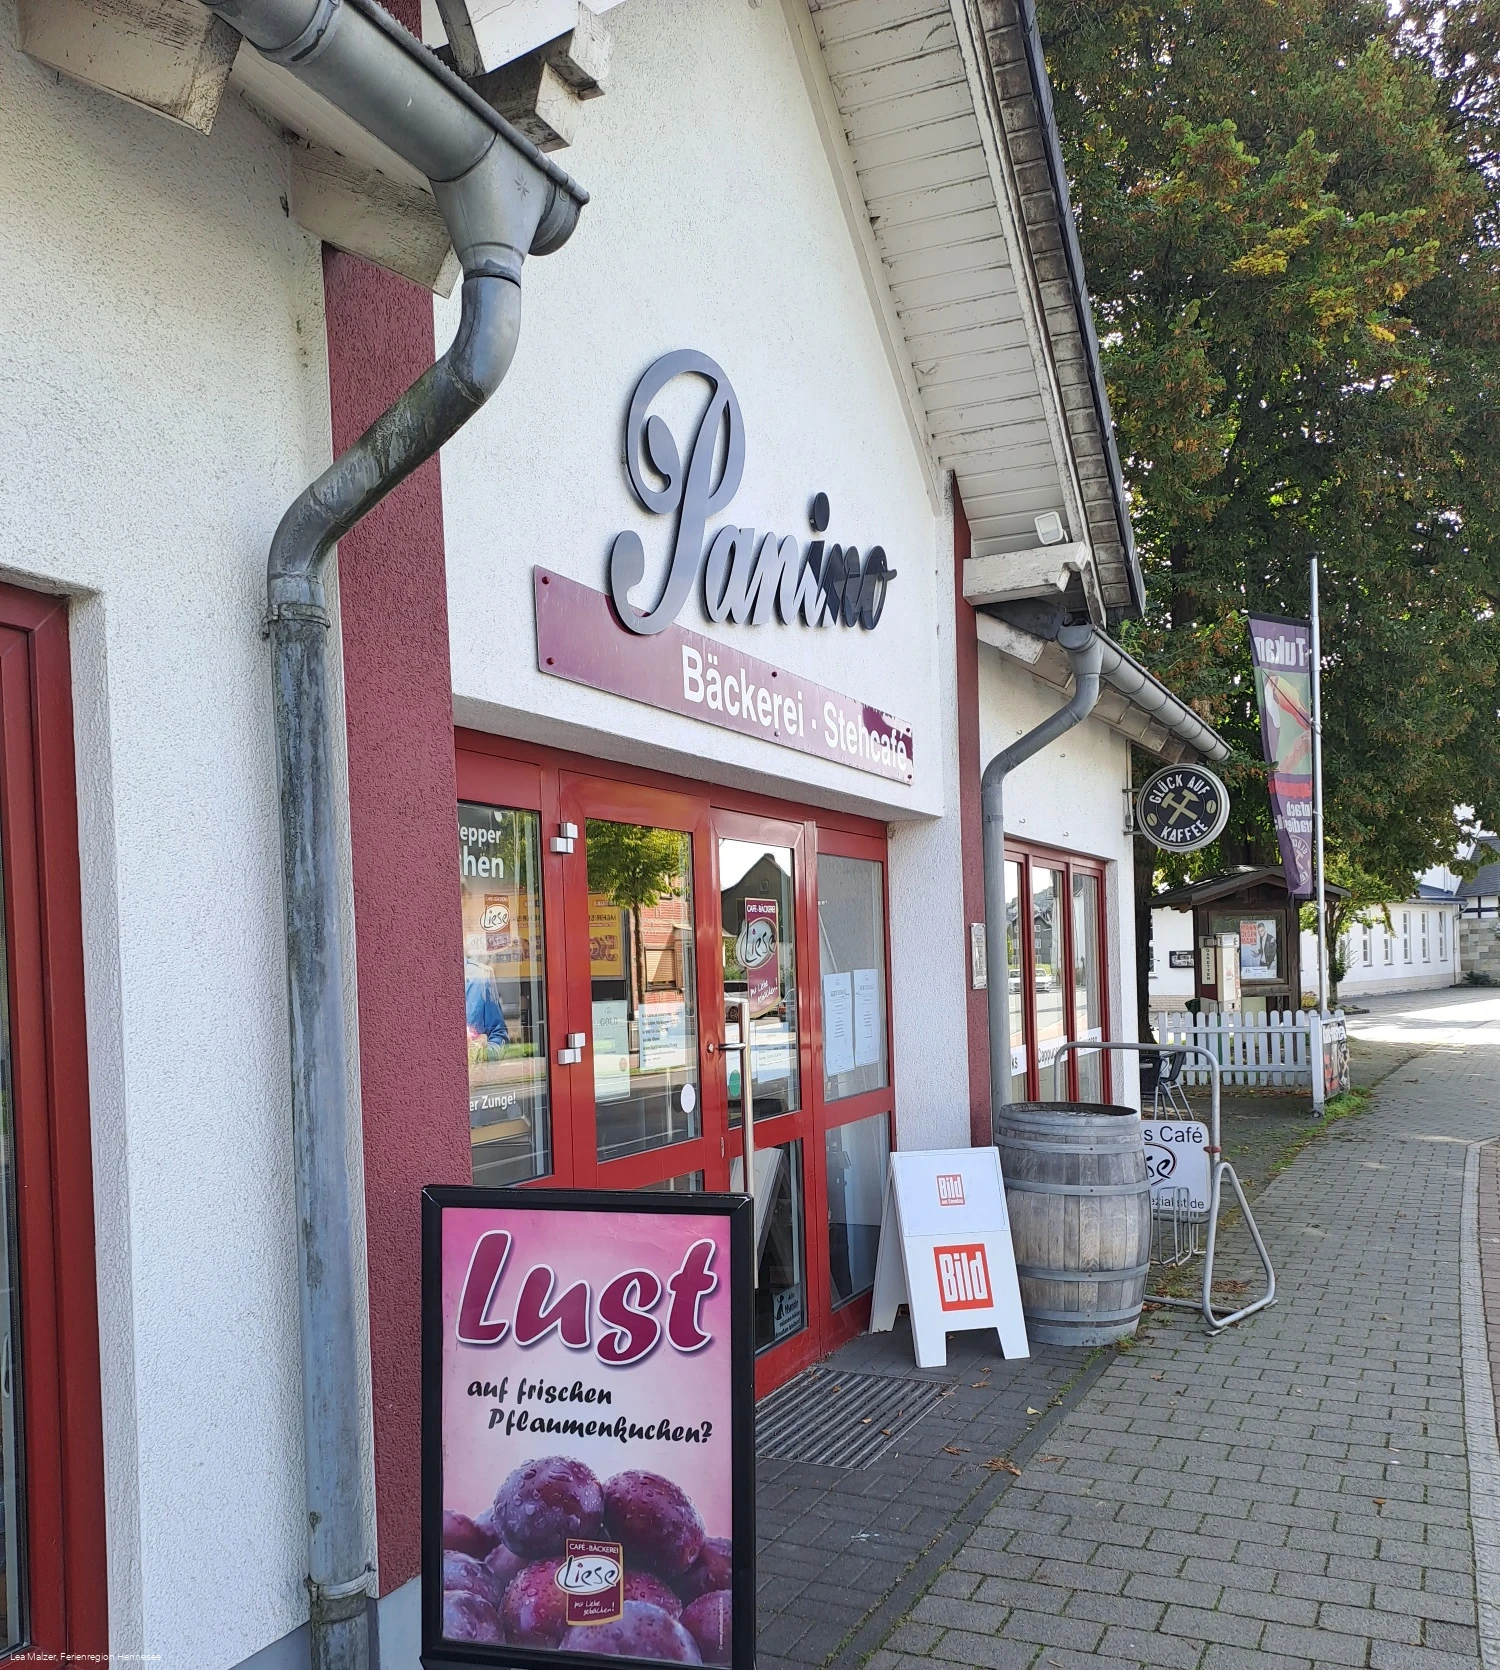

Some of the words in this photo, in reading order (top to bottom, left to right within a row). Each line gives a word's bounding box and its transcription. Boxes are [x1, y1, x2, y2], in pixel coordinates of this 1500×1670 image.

[611, 348, 897, 635] Panino
[682, 644, 804, 737] Bäckerei
[823, 701, 907, 771] Stehcafé
[1149, 774, 1183, 804] GLÜCK
[1187, 776, 1211, 795] AUF
[459, 825, 501, 847] epper
[1160, 820, 1208, 842] KAFFEE
[461, 845, 504, 879] hen
[484, 906, 508, 928] Liese
[745, 921, 775, 963] Liese
[470, 1100, 479, 1111] er
[481, 1091, 516, 1110] Zunge!
[1143, 1129, 1153, 1141] s
[1160, 1126, 1203, 1143] Café
[938, 1176, 963, 1198] Bild
[938, 1251, 989, 1302] Bild
[456, 1229, 718, 1365] Lust
[467, 1377, 509, 1401] auf
[516, 1376, 612, 1405] frischen
[488, 1408, 713, 1444] Pflaumenkuchen?
[564, 1556, 616, 1588] Liese
